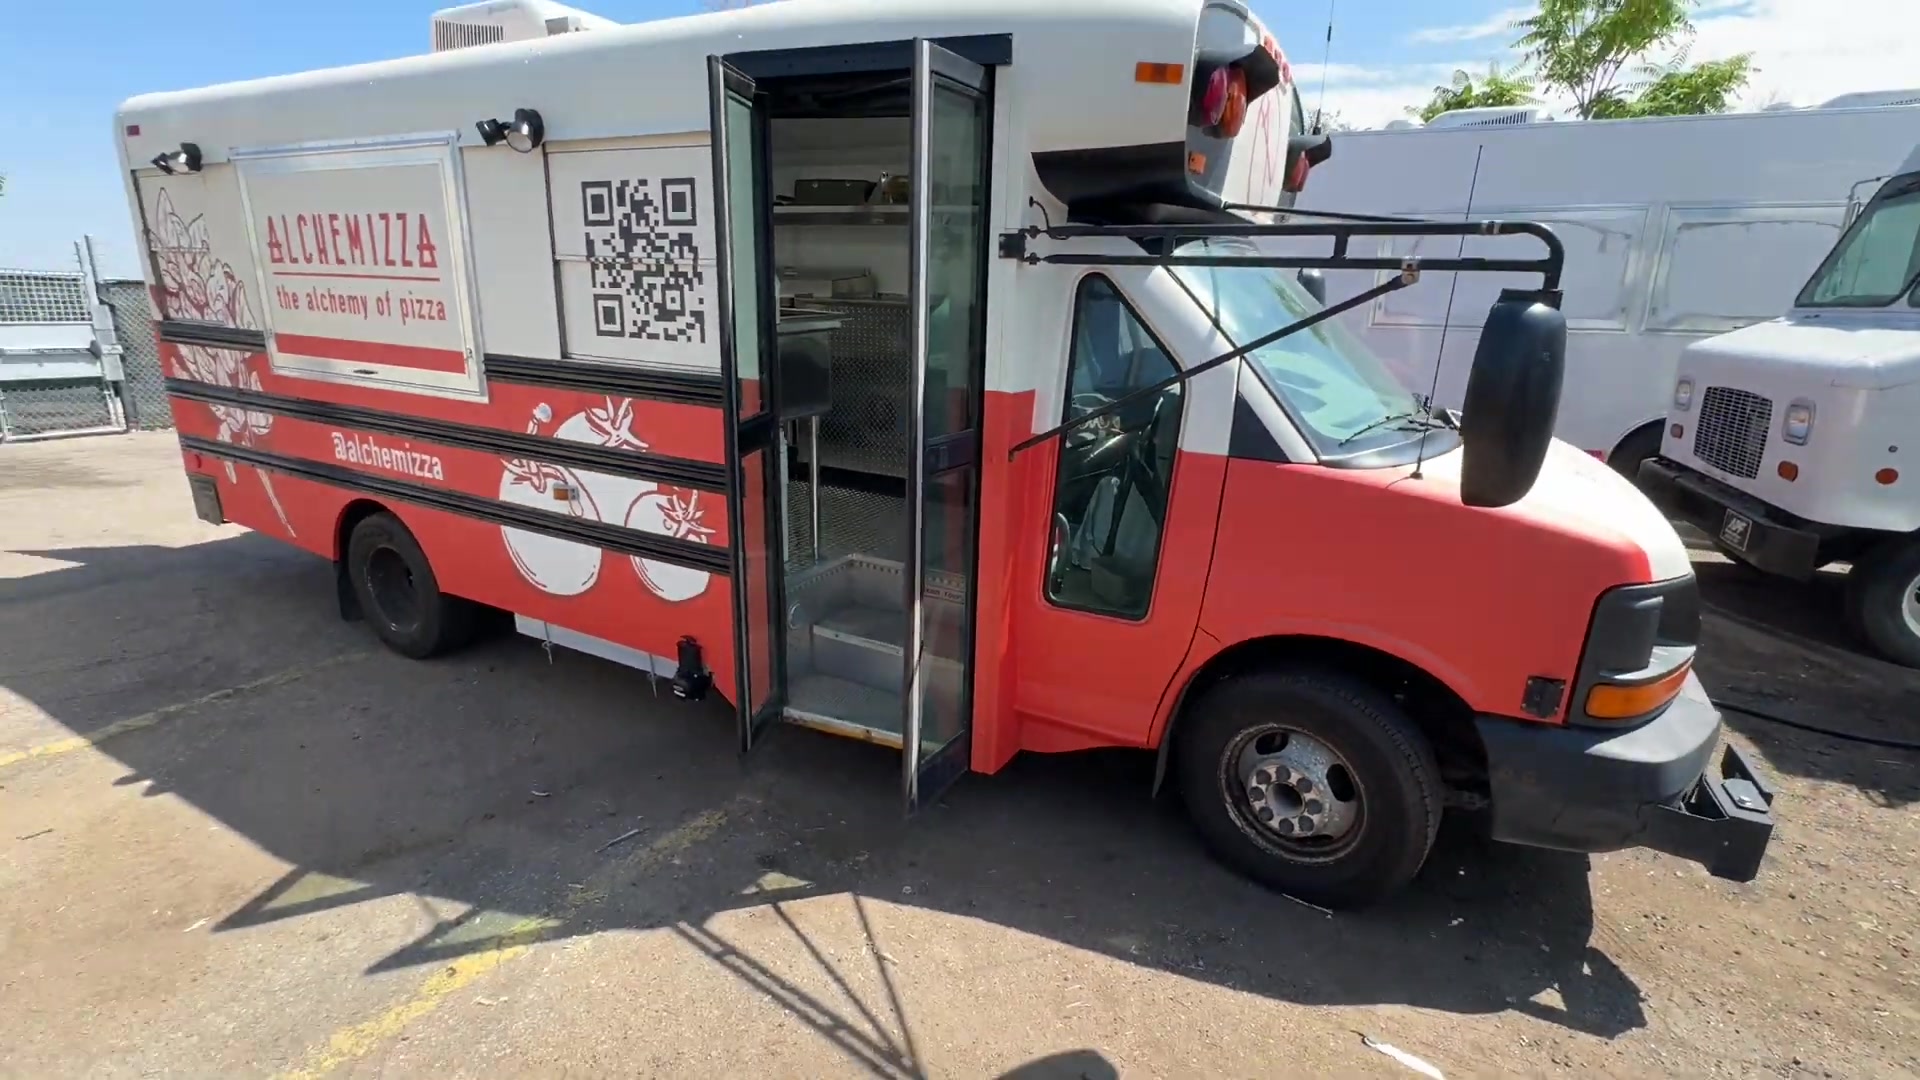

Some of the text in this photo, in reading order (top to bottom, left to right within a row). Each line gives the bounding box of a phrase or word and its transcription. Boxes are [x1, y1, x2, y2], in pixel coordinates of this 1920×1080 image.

[267, 212, 438, 268] ALCHEMIZZA
[276, 285, 447, 326] the alchemy of pizza
[331, 431, 444, 481] @alchemizza
